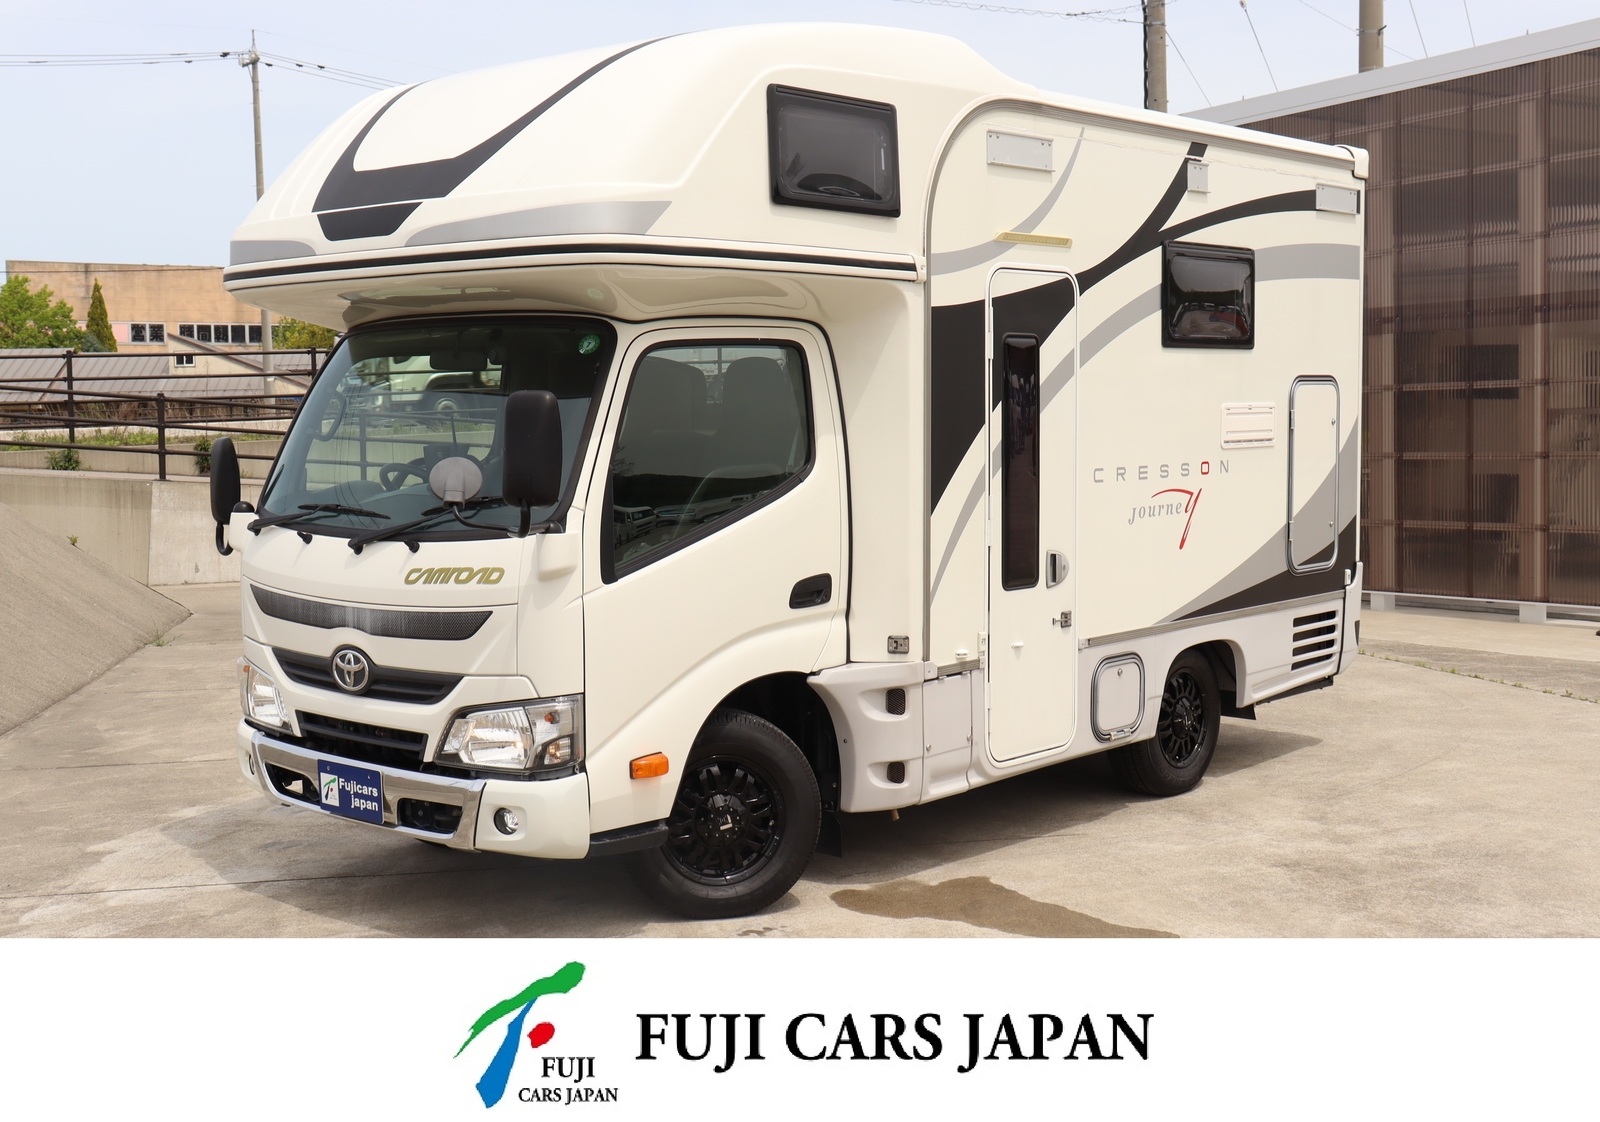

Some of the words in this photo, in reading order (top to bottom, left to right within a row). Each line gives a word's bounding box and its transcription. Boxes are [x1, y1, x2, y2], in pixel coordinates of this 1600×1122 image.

[1093, 460, 1229, 483] CRESSON
[404, 566, 505, 585] CAMROAD
[338, 777, 378, 797] Fujicars
[351, 794, 379, 811] japan
